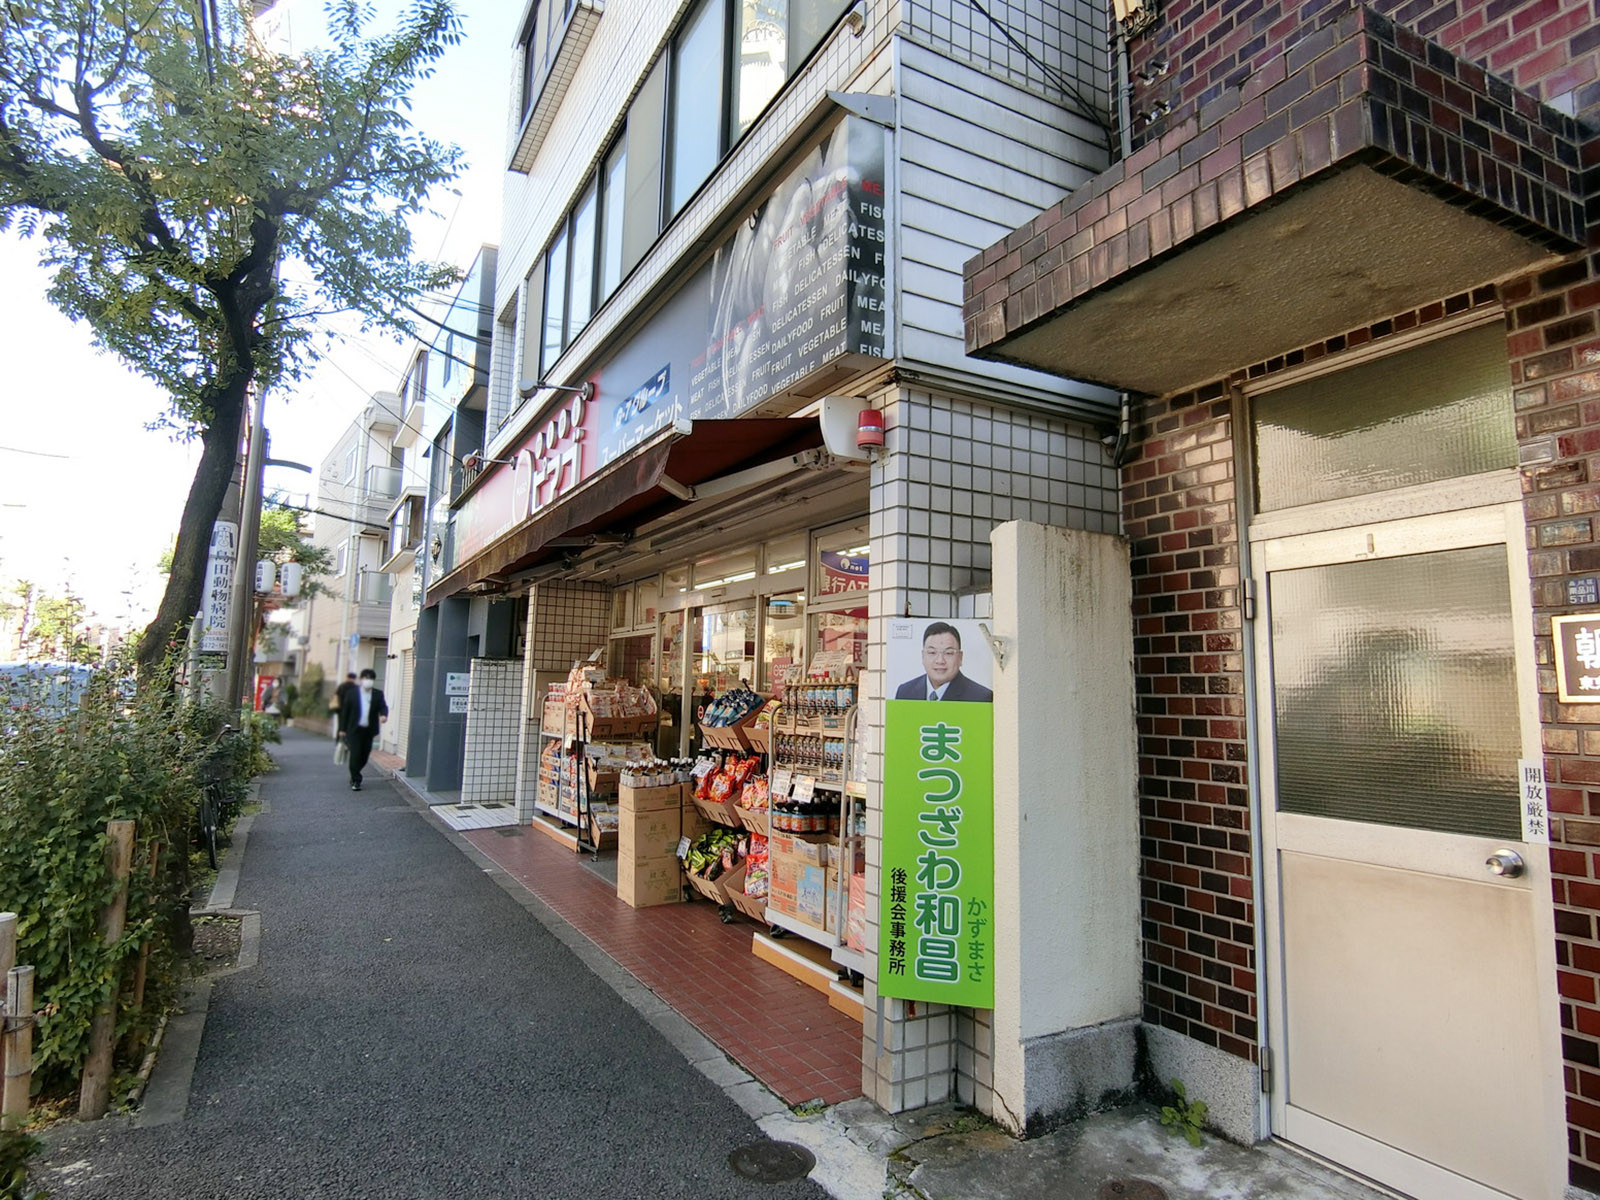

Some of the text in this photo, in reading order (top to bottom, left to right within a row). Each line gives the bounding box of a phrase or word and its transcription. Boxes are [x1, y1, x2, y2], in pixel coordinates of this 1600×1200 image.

[772, 225, 793, 249] FRUIT
[861, 179, 885, 197] ME
[772, 245, 885, 313] FISH DELICATESSEN F
[798, 248, 816, 271] FISH
[771, 284, 828, 334] DELICATESSEN
[771, 317, 814, 355] DAILYFOOD
[820, 294, 846, 321] FRUIT
[691, 357, 722, 386] VEGETABLE
[771, 353, 792, 376] FRUIT
[797, 317, 847, 358] VEGETABLE
[771, 360, 816, 395] VEGETABLE
[822, 341, 846, 364] MEAT
[690, 387, 704, 404] MEAT
[707, 378, 721, 392] FISH
[704, 379, 747, 413] DELICAESSEN
[751, 360, 771, 382] FRUIT
[732, 383, 768, 413] DAILYFOOD
[1569, 594, 1596, 604] 5丁目
[1523, 766, 1545, 836] 開放厳禁
[914, 721, 964, 984] まつざわ和昌
[888, 866, 908, 976] 後援会事務所
[967, 896, 987, 983] かずまさ
